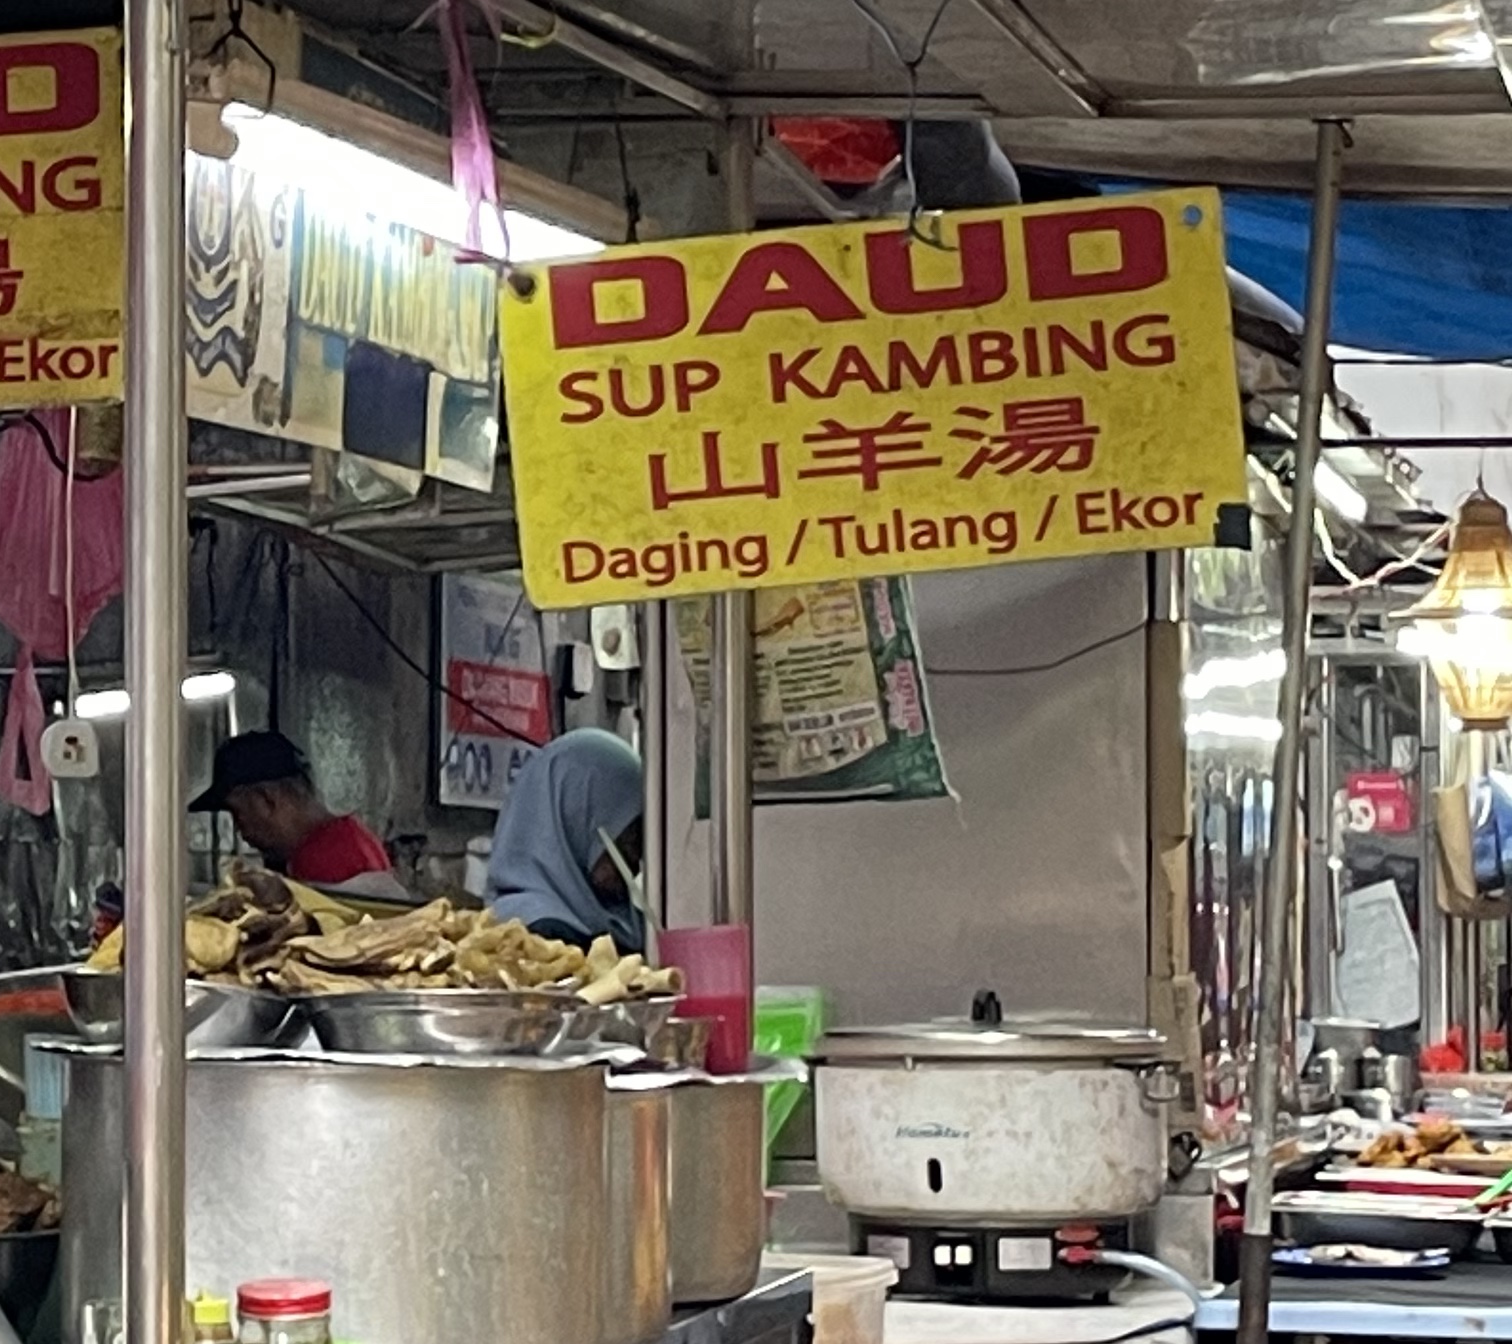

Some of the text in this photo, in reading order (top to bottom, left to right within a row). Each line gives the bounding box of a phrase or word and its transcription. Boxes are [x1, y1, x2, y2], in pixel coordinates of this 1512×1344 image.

[548, 205, 1169, 349] DAUD
[558, 314, 1177, 424] SUP KAMBING
[648, 396, 1101, 511] 山羊湯
[561, 531, 770, 587] Daging
[819, 509, 1019, 554] Tulang
[1075, 490, 1205, 536] Ekor
